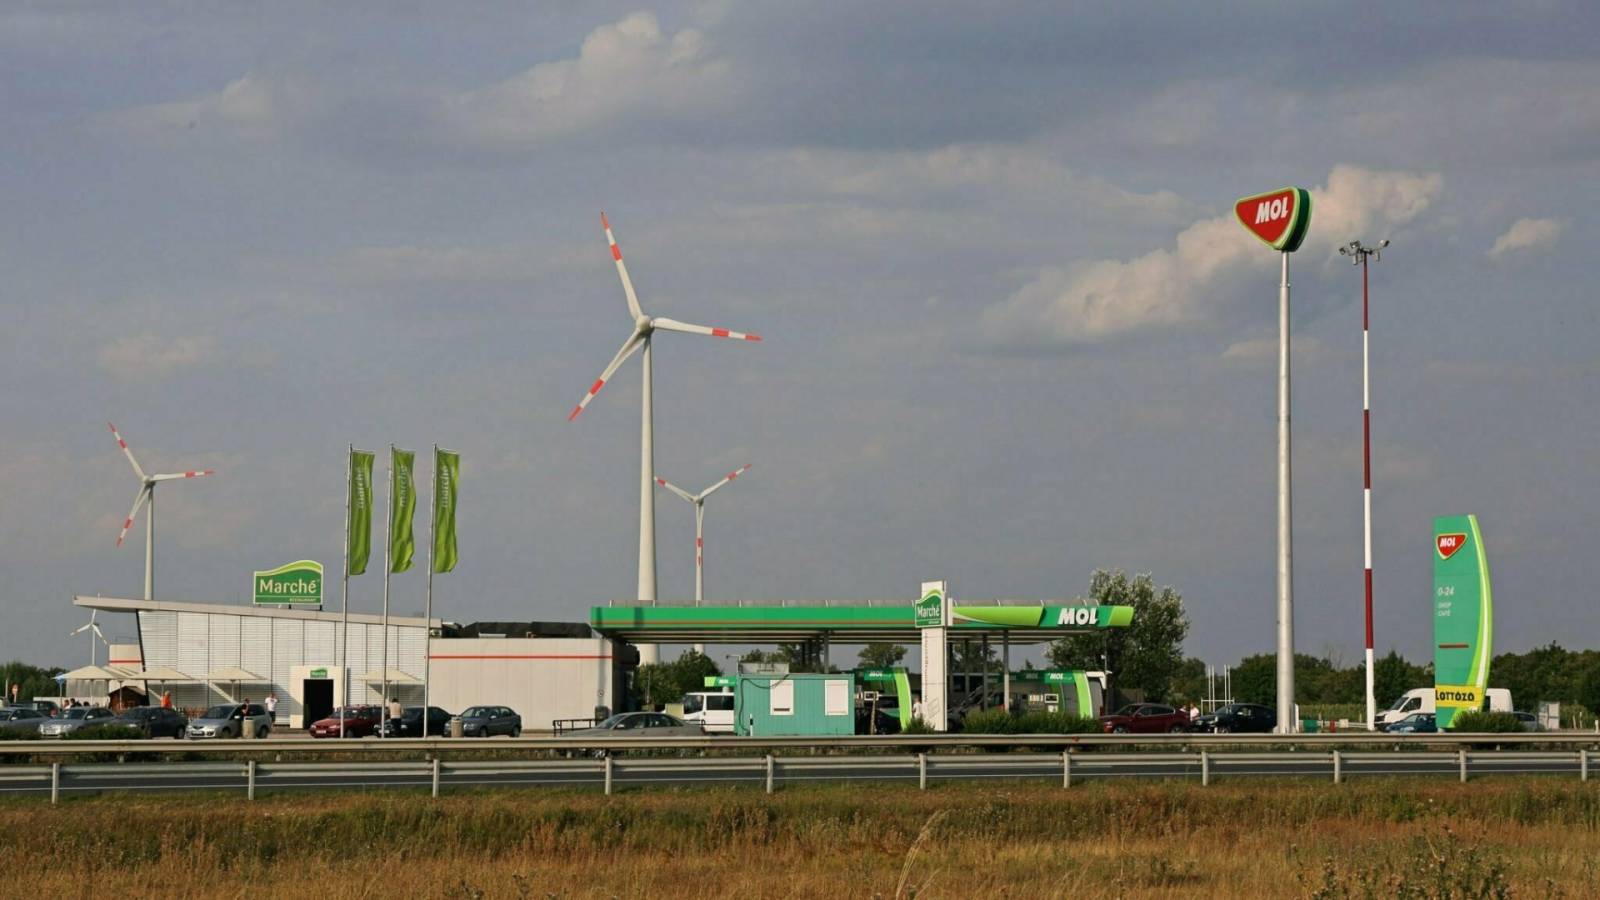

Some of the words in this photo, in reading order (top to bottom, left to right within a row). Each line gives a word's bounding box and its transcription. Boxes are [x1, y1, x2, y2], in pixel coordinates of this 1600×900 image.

[1255, 196, 1289, 225] MOL
[1440, 536, 1456, 547] MOL
[259, 578, 317, 594] Marché
[916, 604, 940, 618] Marché
[1058, 608, 1098, 625] MOL
